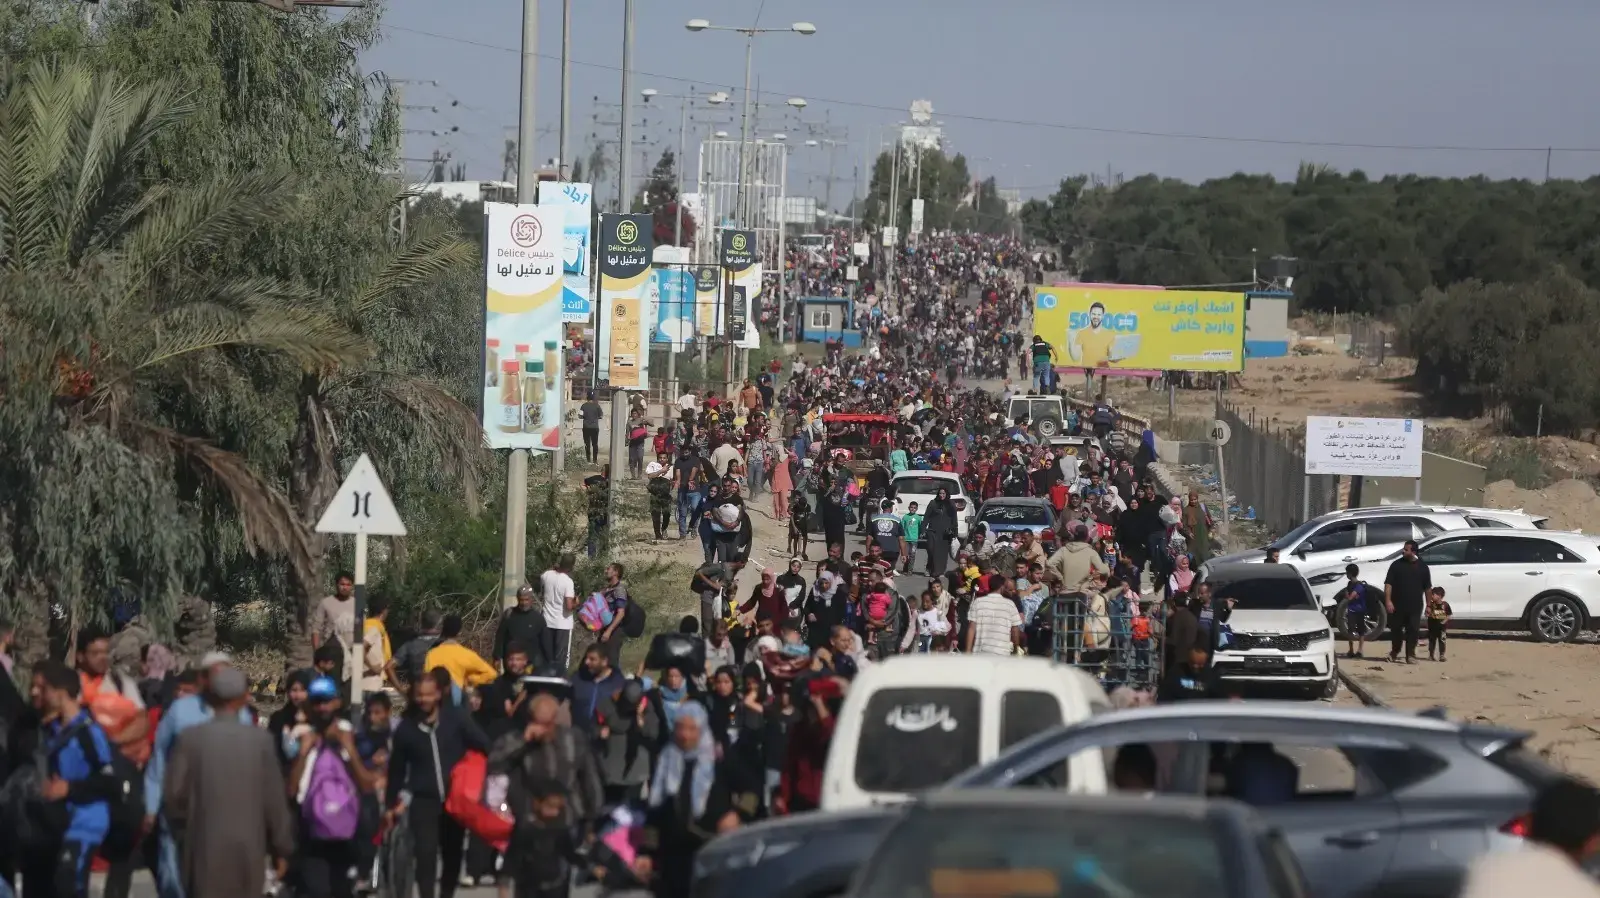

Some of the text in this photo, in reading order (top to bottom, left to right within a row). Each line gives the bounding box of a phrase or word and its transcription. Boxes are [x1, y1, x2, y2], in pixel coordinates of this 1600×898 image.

[497, 248, 526, 258] Délice
[608, 244, 627, 252] Délice
[528, 250, 554, 259] ديليس
[608, 255, 646, 265] لا مثيل لها
[497, 263, 554, 277] لا مثيل لها
[1212, 428, 1223, 440] 40
